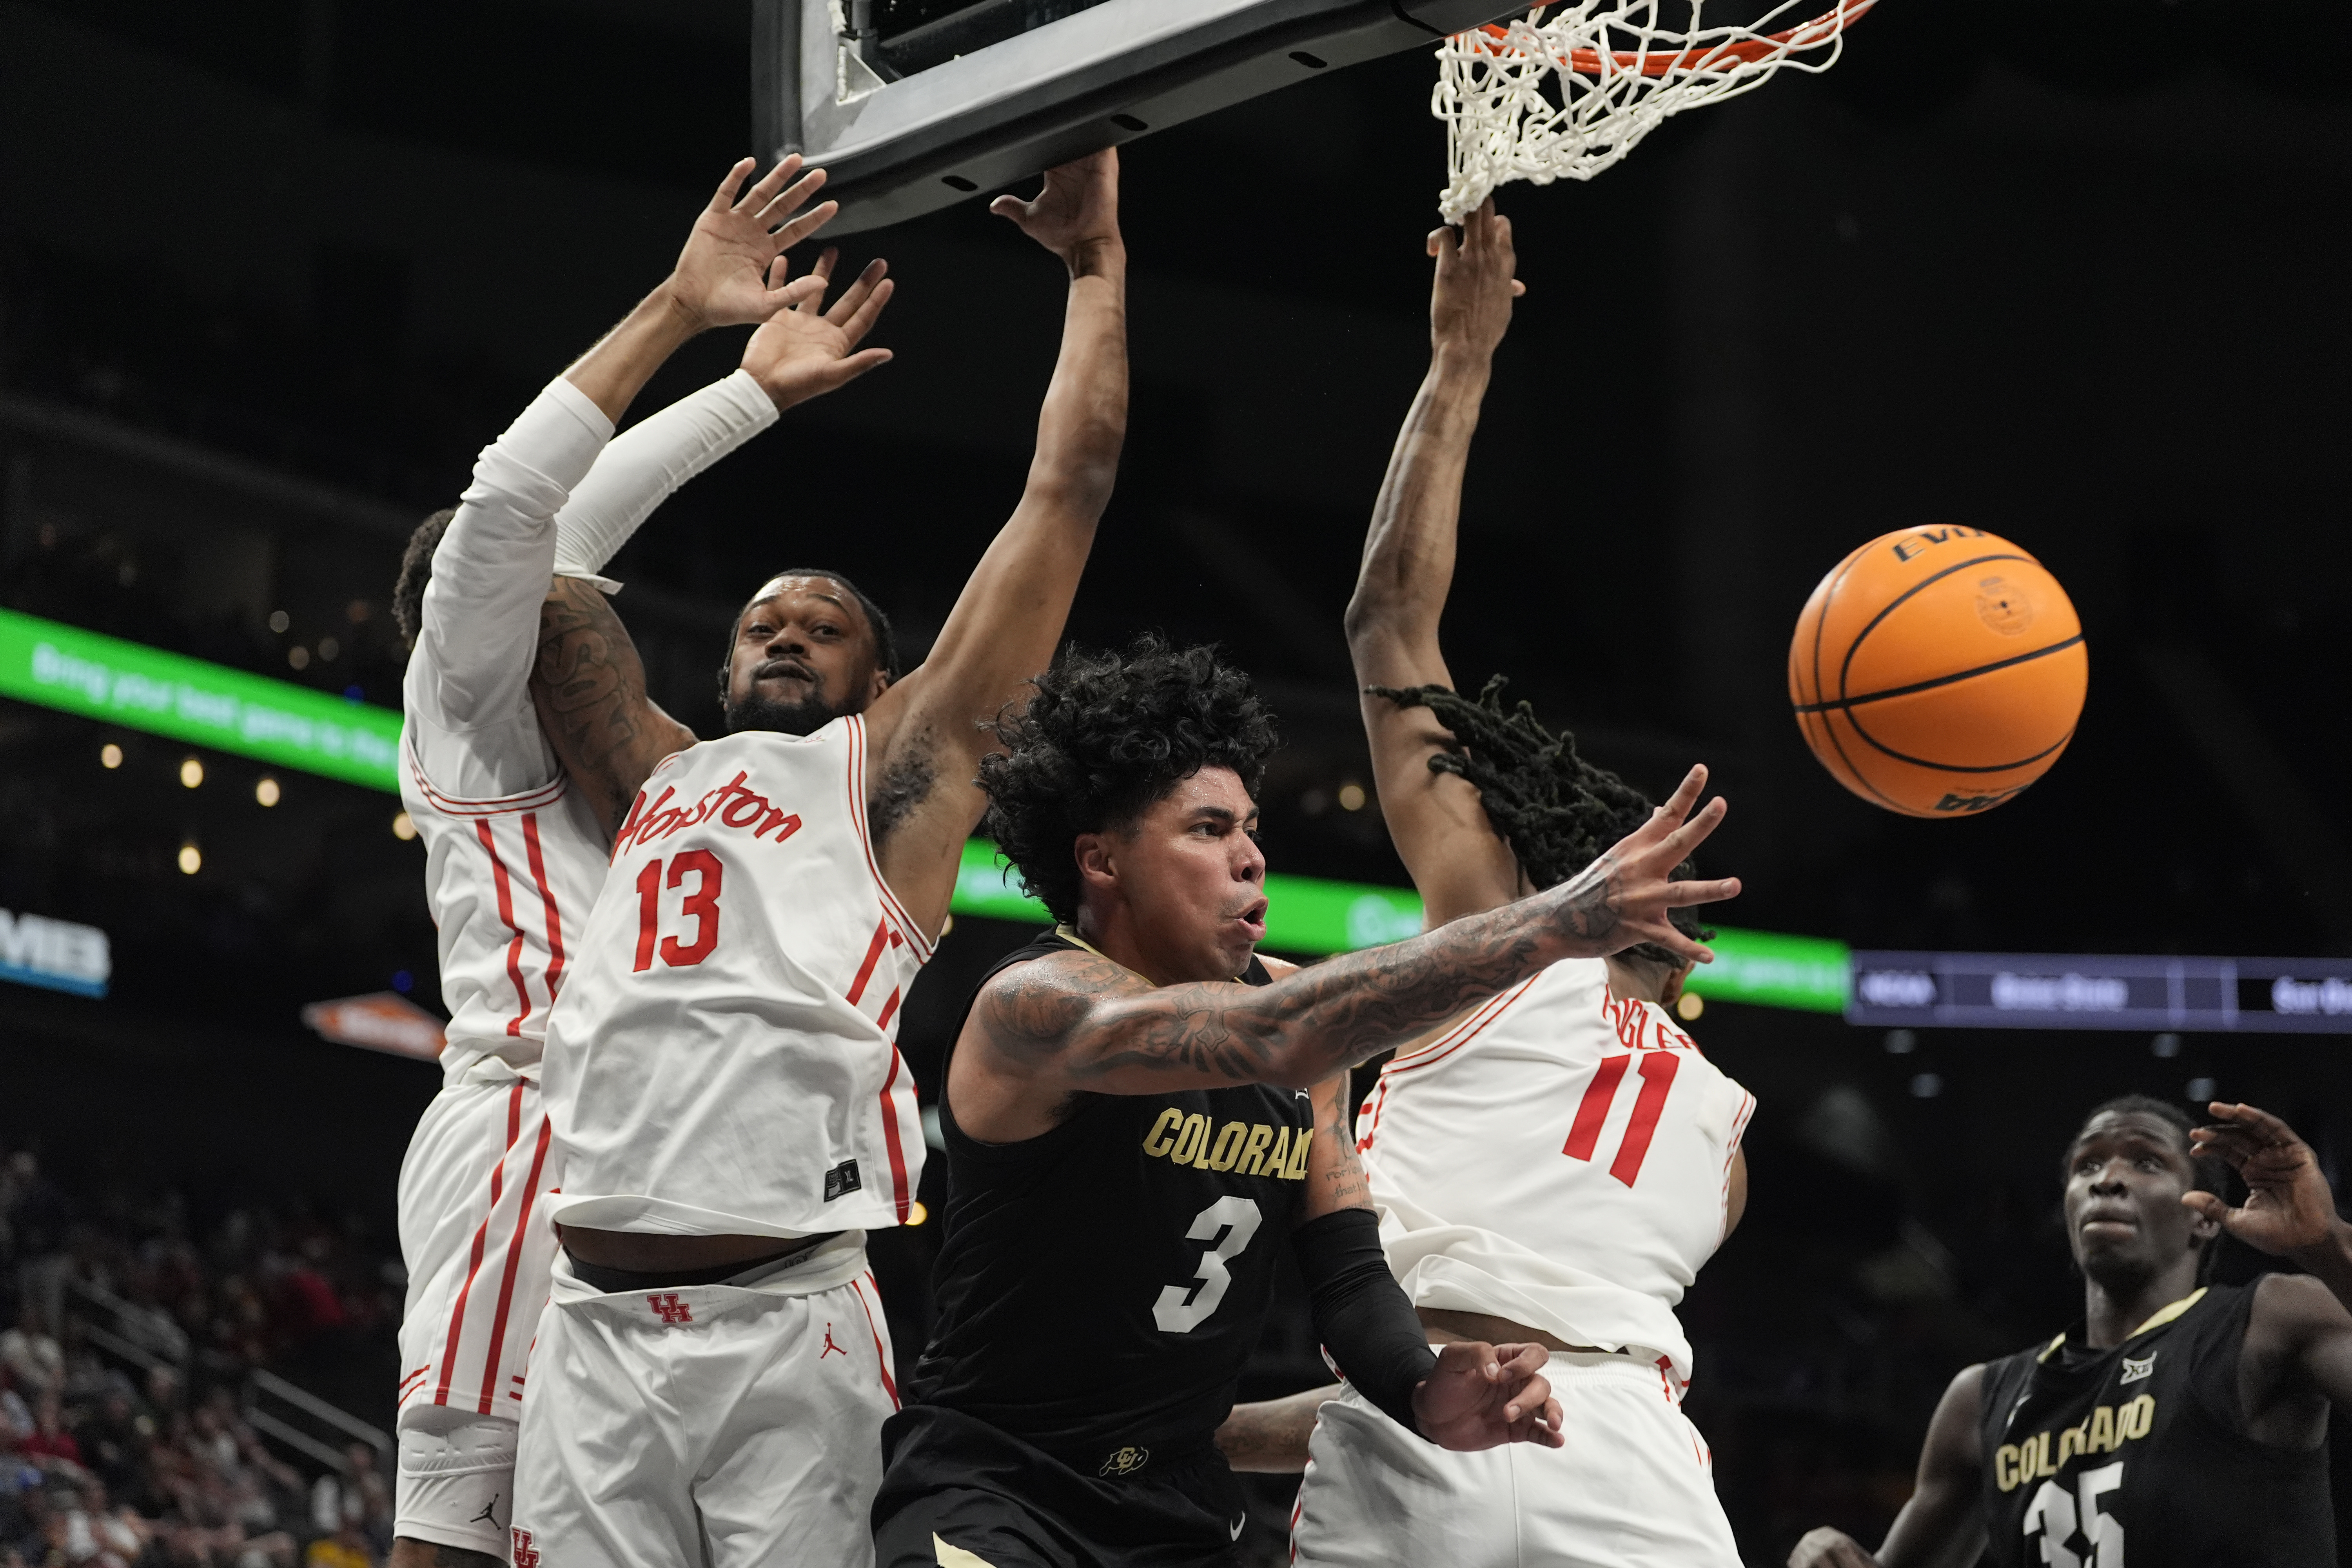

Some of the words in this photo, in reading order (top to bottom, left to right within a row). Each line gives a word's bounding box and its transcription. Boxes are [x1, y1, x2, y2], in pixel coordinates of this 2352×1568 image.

[31, 642, 112, 705] Bring
[610, 770, 802, 867] Houston
[633, 849, 722, 972] 13
[1562, 1051, 1680, 1189] 11
[647, 1293, 693, 1323] UH
[1152, 1196, 1262, 1333] 3
[2023, 1461, 2124, 1568] 35
